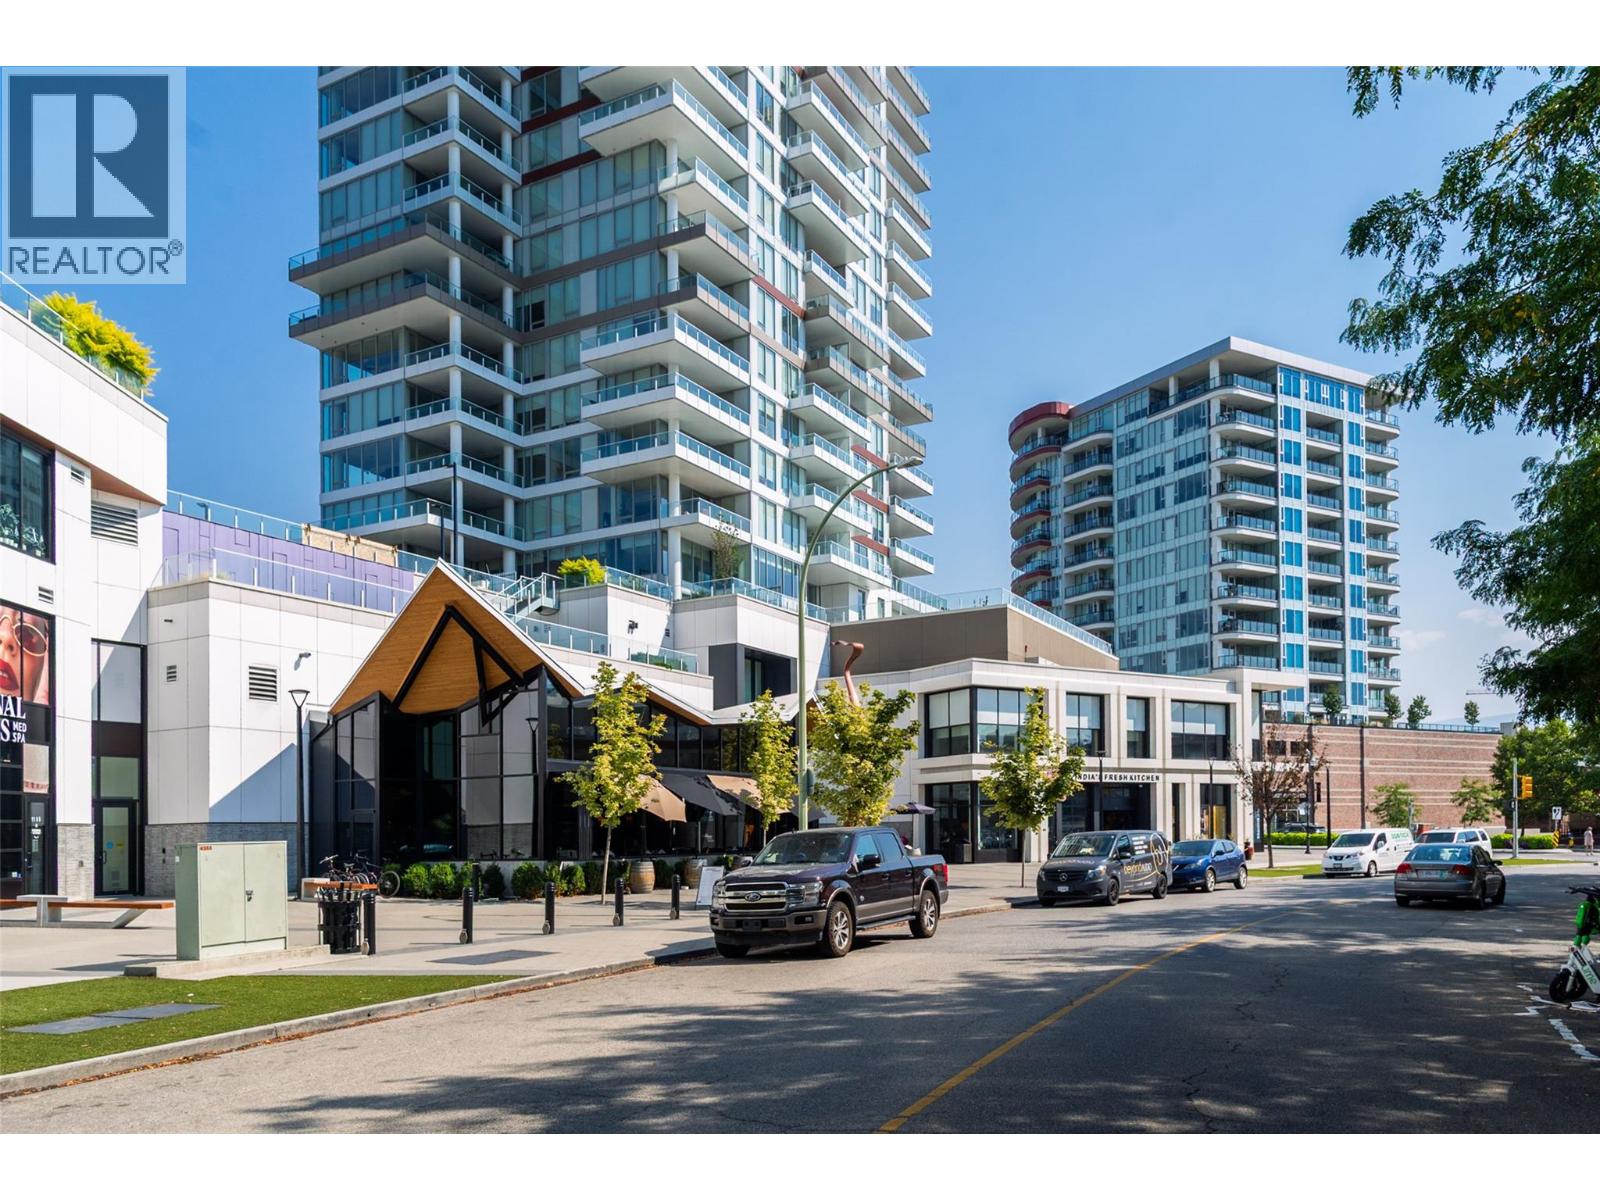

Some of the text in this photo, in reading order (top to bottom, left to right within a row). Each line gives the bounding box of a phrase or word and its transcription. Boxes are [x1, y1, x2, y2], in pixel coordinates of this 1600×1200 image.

[13, 721, 28, 733] MED
[12, 733, 26, 744] SPA
[1128, 774, 1160, 782] KITCHEN
